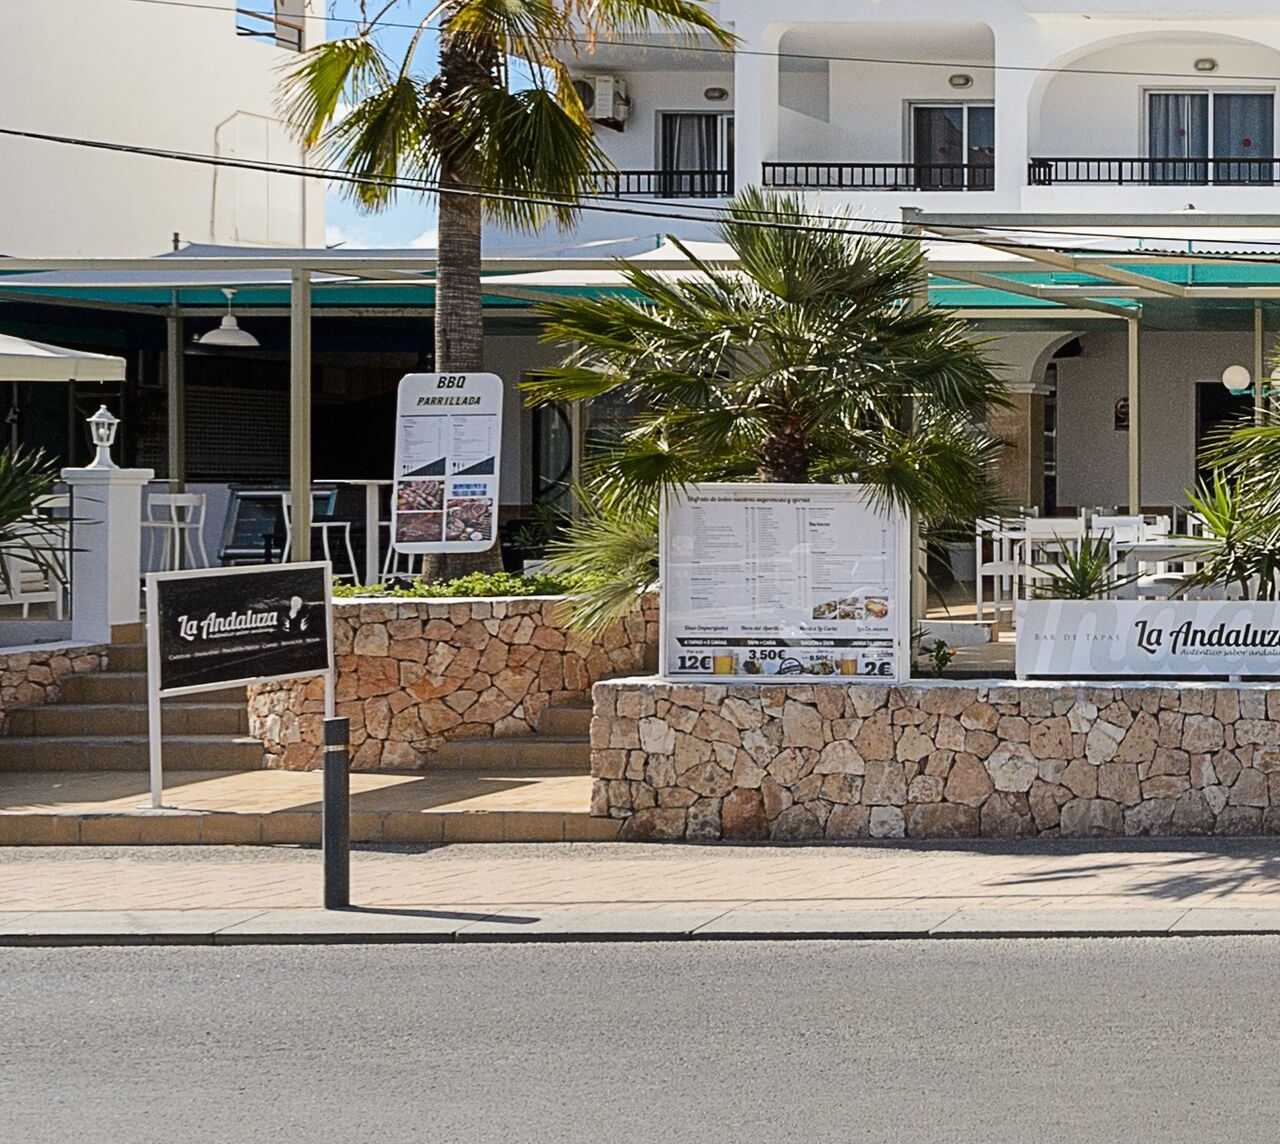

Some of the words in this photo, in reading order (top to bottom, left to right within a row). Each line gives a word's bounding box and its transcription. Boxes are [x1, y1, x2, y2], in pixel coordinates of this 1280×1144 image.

[436, 375, 467, 389] BBQ
[416, 396, 482, 407] PARRILLADA
[177, 615, 198, 642] La
[199, 609, 279, 640] Andaluza
[1034, 632, 1057, 642] BAR
[1064, 633, 1078, 642] DE
[1085, 632, 1121, 642] TAPAS
[1134, 619, 1163, 655] La
[677, 655, 712, 671] 12€
[864, 661, 892, 675] 2€
